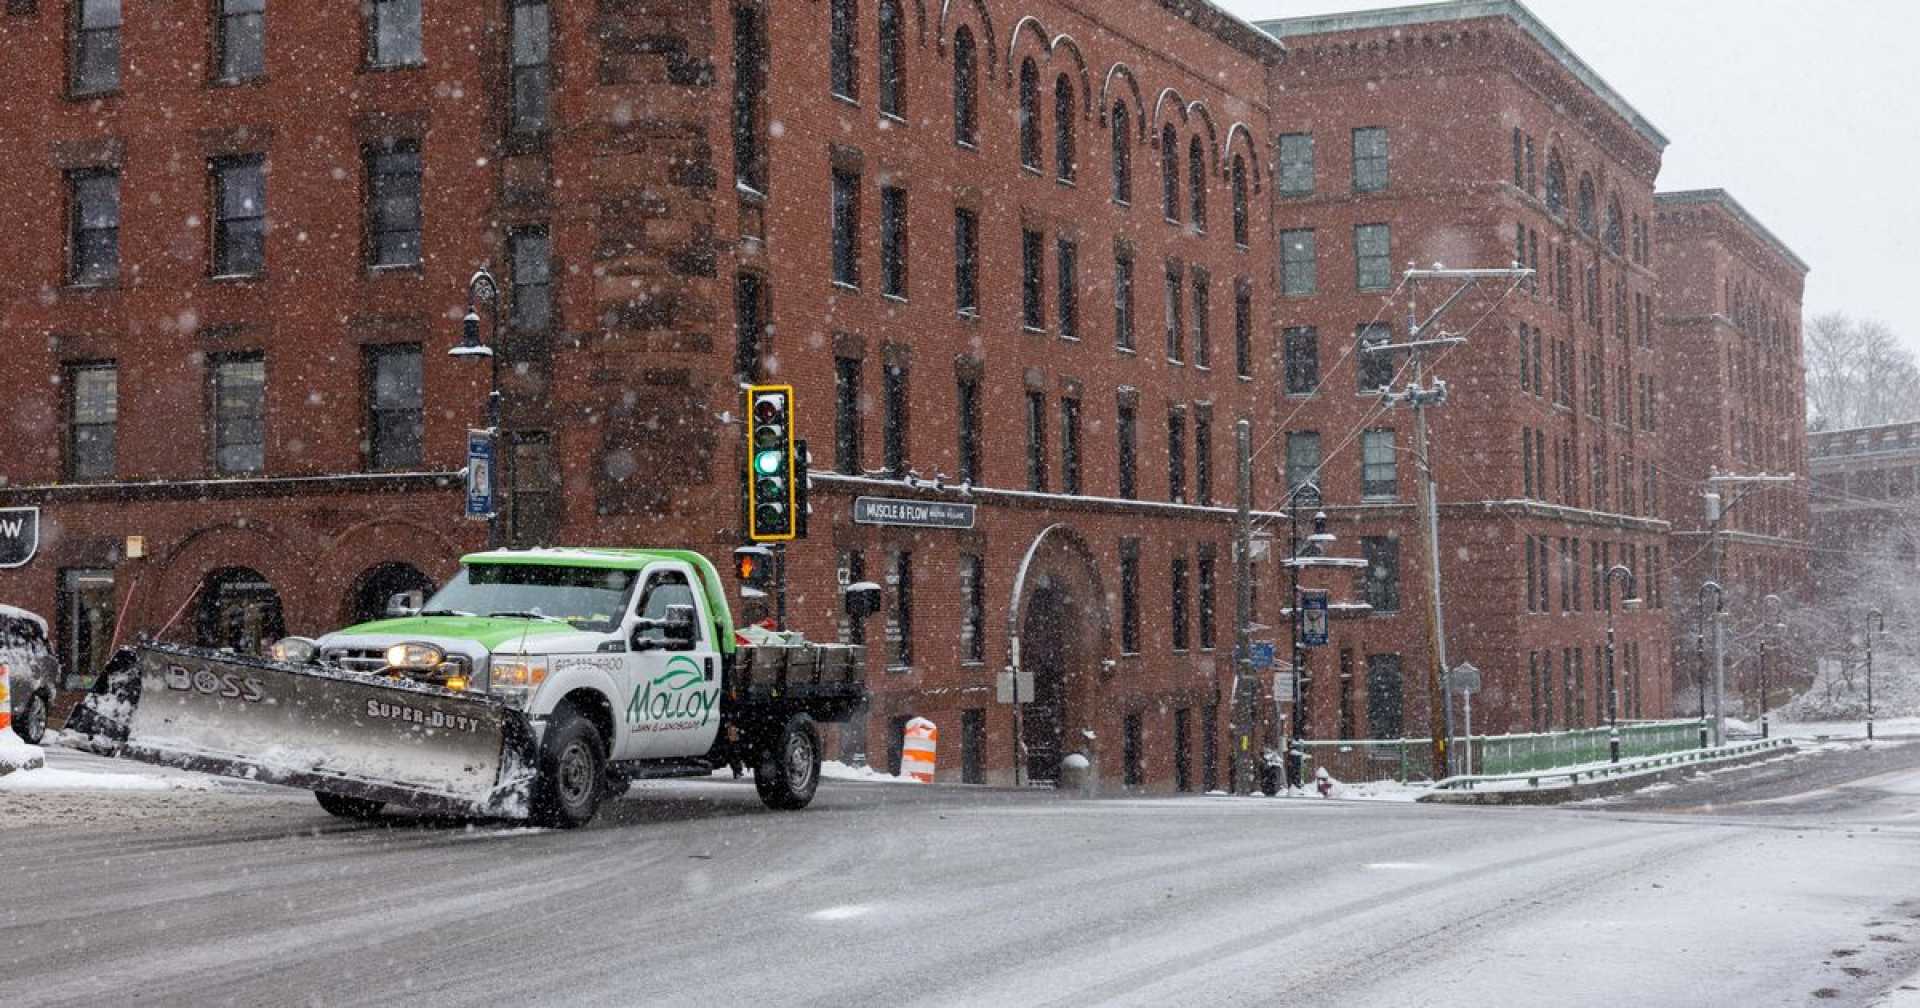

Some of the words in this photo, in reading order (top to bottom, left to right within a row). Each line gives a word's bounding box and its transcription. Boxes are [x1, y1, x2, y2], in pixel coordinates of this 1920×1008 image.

[866, 503, 898, 518] MUSCLE
[899, 505, 905, 519] &
[906, 506, 929, 521] FLOW
[0, 518, 23, 538] W
[165, 664, 263, 701] BOSS
[367, 699, 479, 733] SUPER-DUTY
